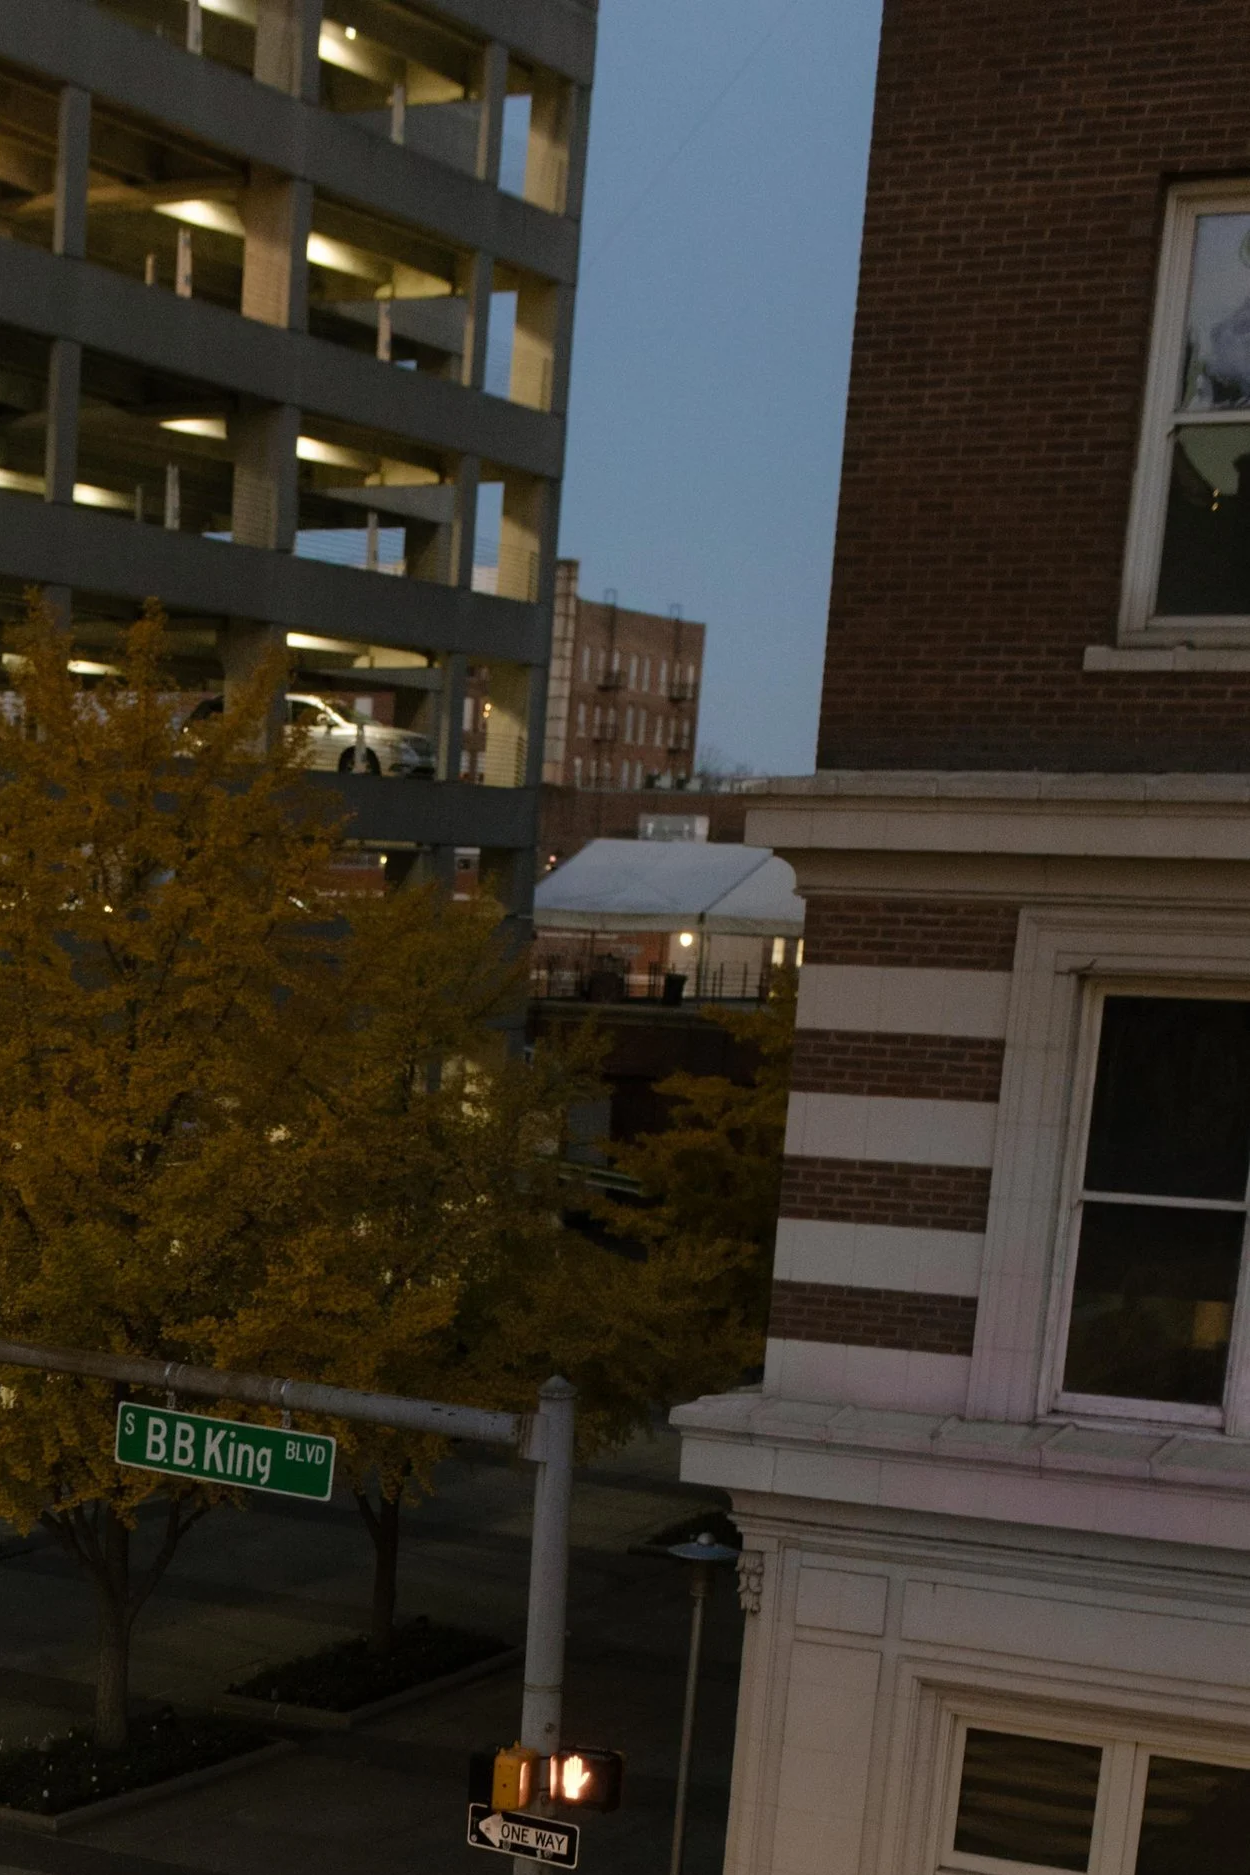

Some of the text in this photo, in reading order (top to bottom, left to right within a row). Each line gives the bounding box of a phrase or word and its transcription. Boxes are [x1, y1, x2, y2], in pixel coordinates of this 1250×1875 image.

[124, 1411, 136, 1436] S
[202, 1426, 273, 1486] King
[285, 1440, 327, 1466] BLVD
[500, 1823, 566, 1851] ONE WAY
